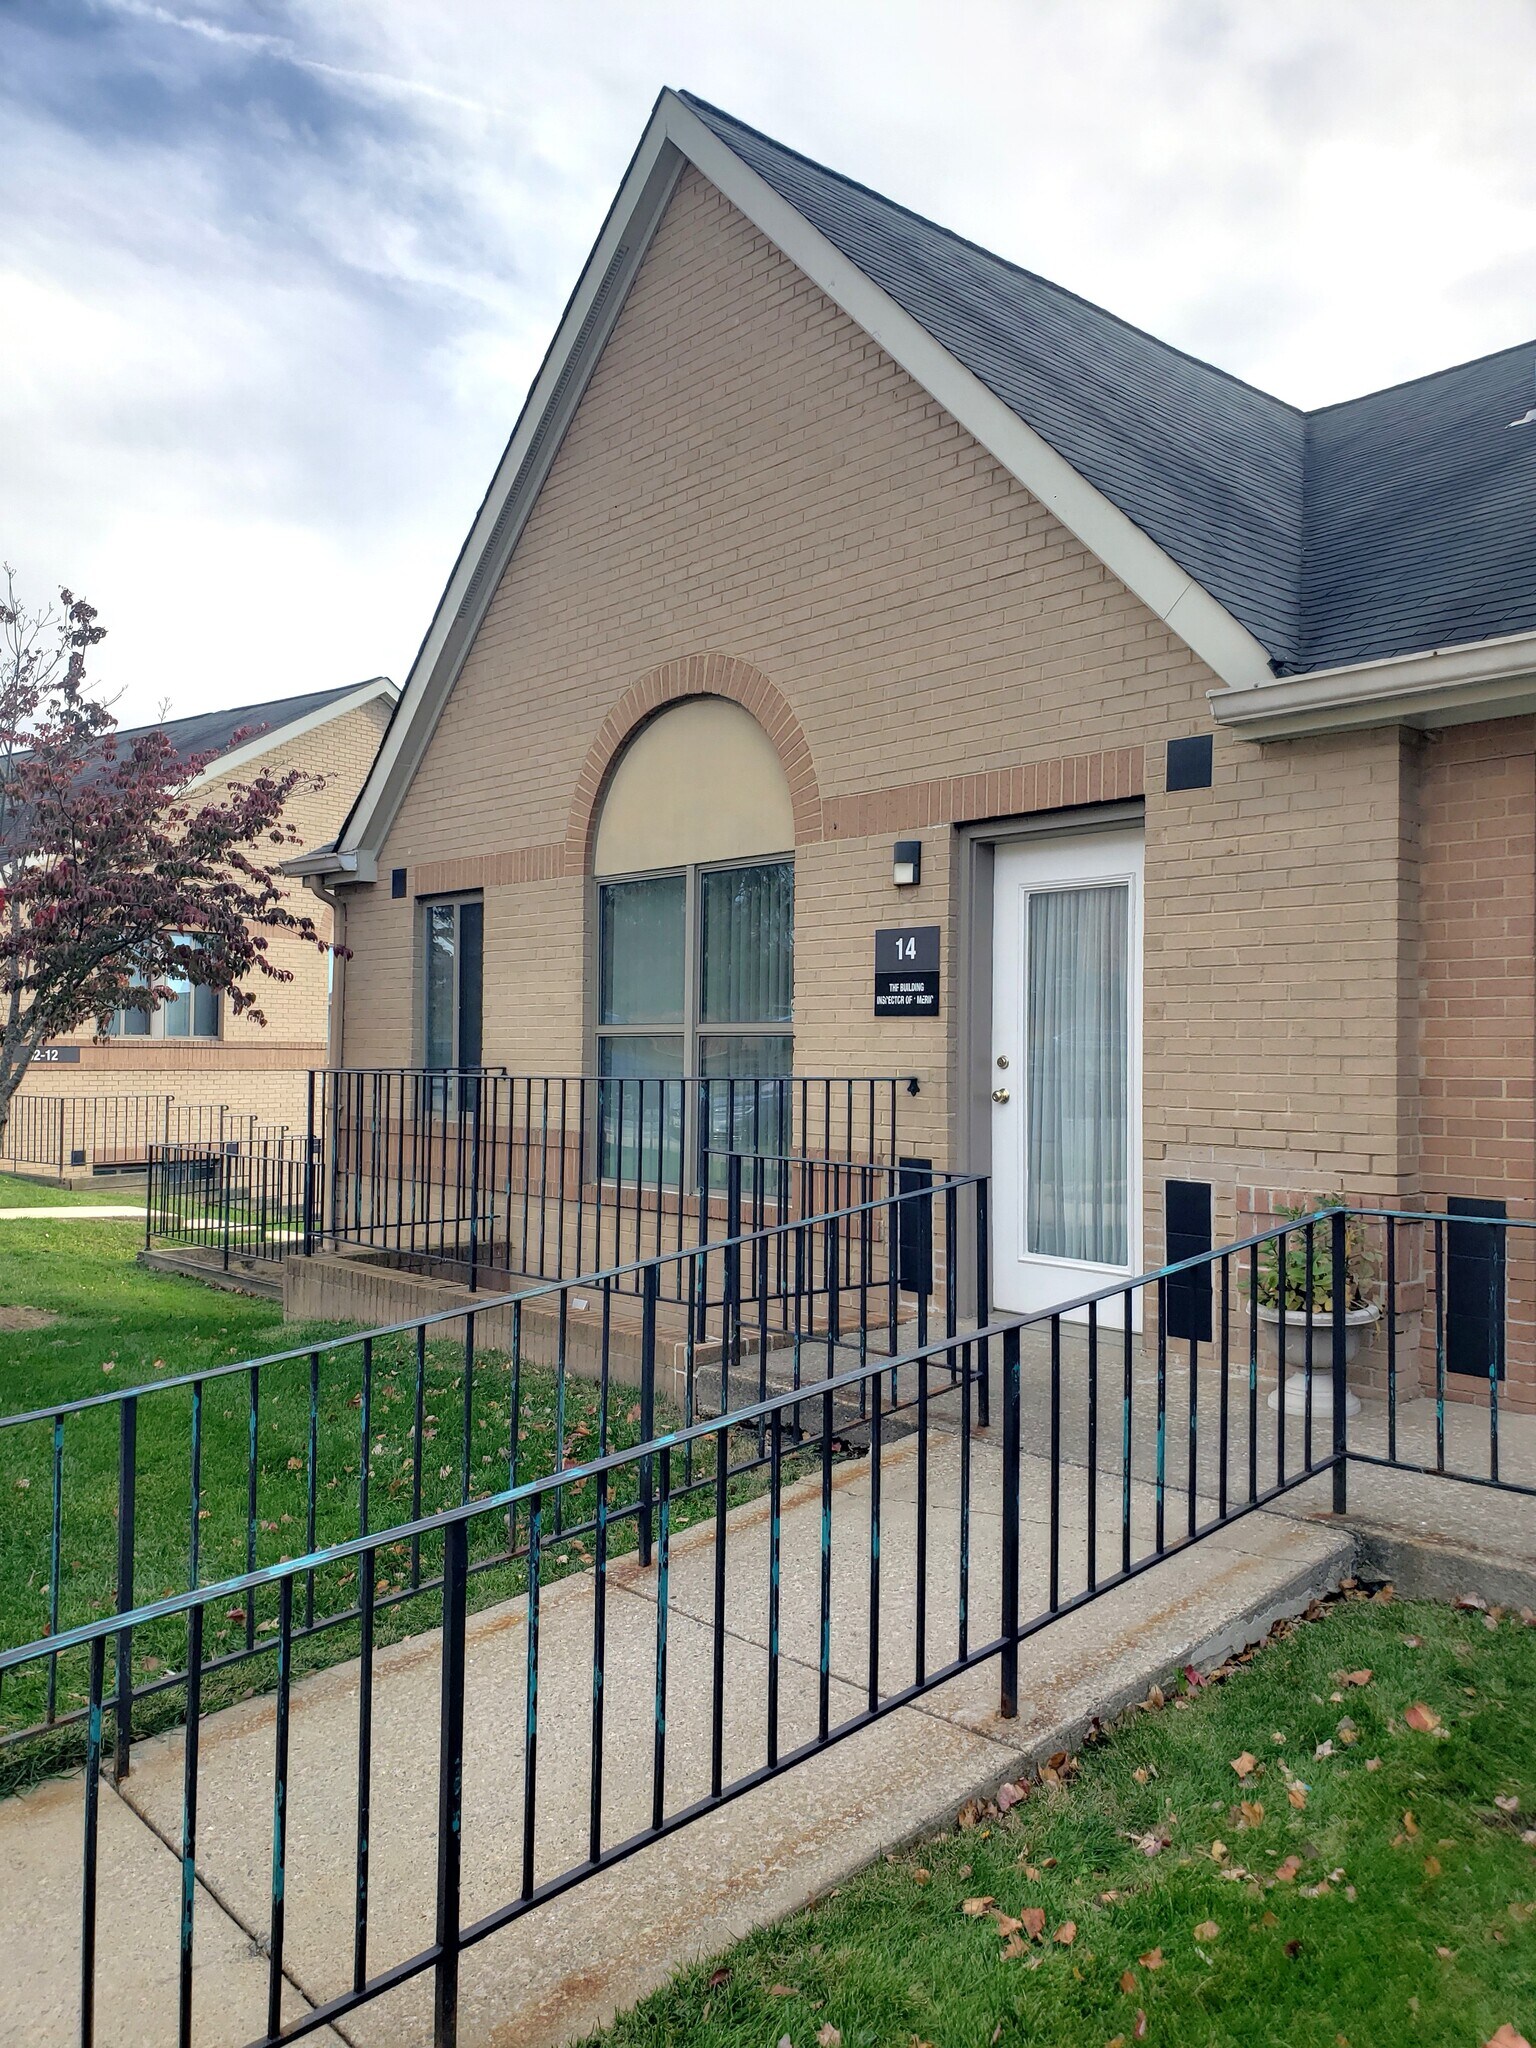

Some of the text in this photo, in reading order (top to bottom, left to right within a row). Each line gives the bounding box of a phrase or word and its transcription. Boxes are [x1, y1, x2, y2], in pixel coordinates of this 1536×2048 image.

[895, 937, 917, 960] 14
[899, 982, 925, 992] BUILDING
[905, 995, 913, 1005] OF
